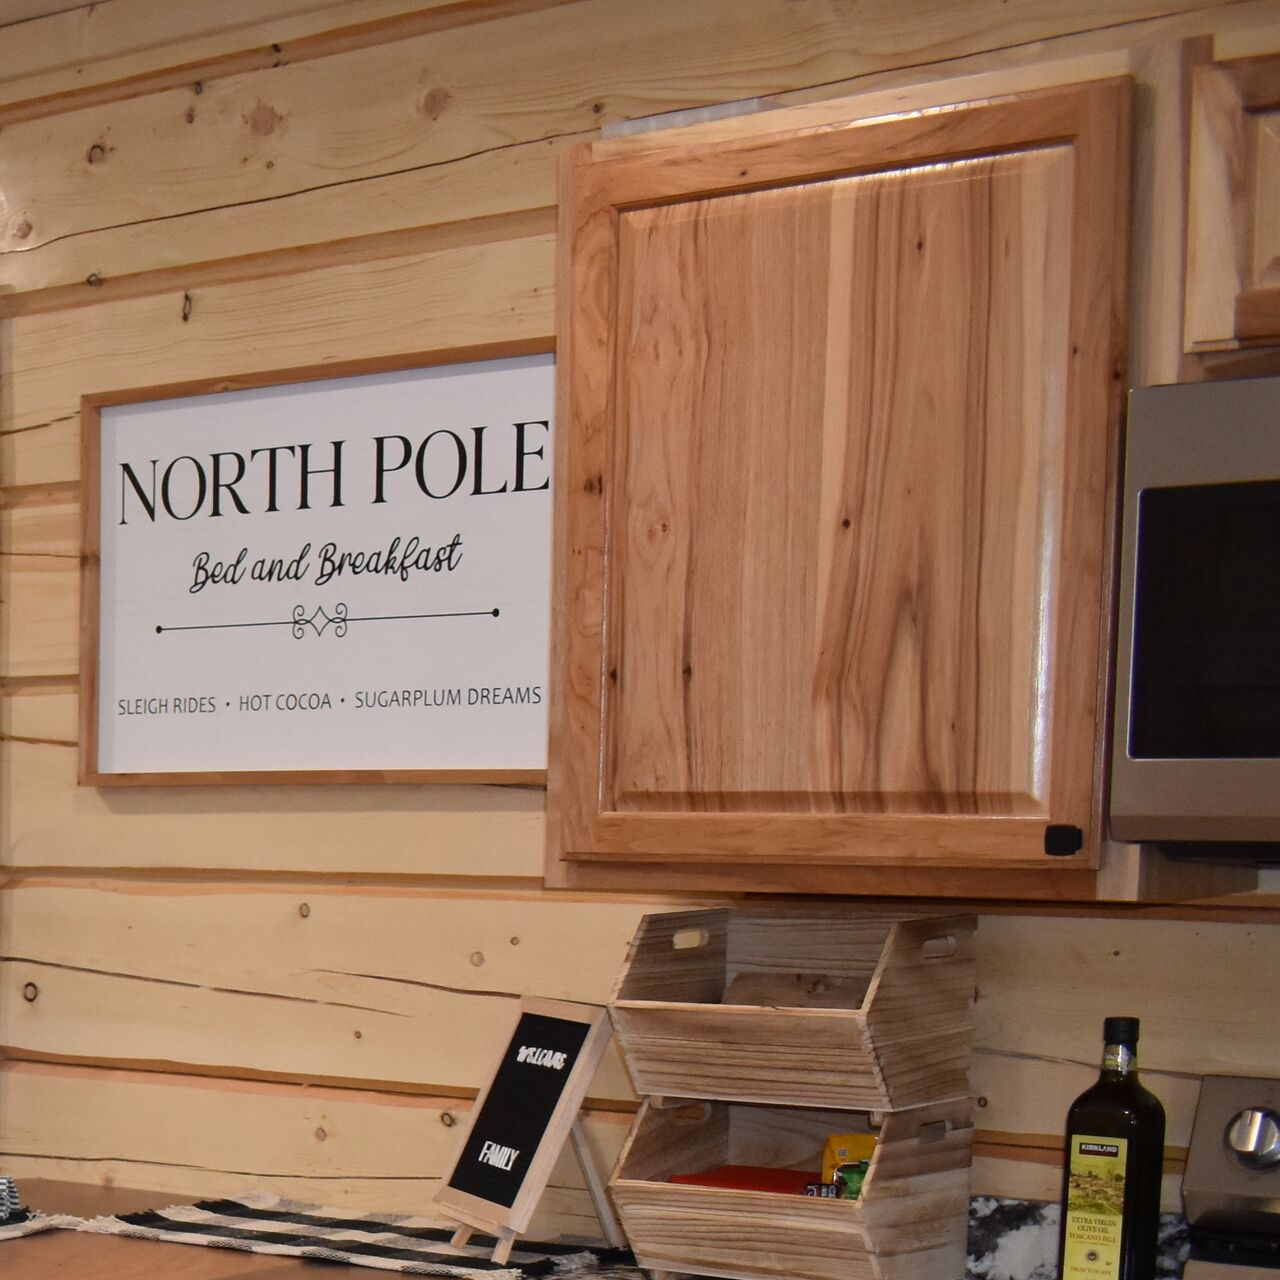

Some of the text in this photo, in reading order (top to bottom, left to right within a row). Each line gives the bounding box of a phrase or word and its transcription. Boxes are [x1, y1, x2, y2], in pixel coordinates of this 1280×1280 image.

[119, 420, 549, 525] NORTH POLE
[189, 533, 463, 594] Bed and Breakfast
[118, 687, 541, 716] SLEIGH RIDES HOT COCOA SUGARPLUM DREAMS
[516, 1045, 567, 1070] WELCOME
[478, 1140, 520, 1171] FAMILY
[1081, 1144, 1118, 1153] KIRKLAND
[1071, 1216, 1117, 1227] EXTRA VIRGIN
[1077, 1225, 1109, 1234] OLIVE OIL
